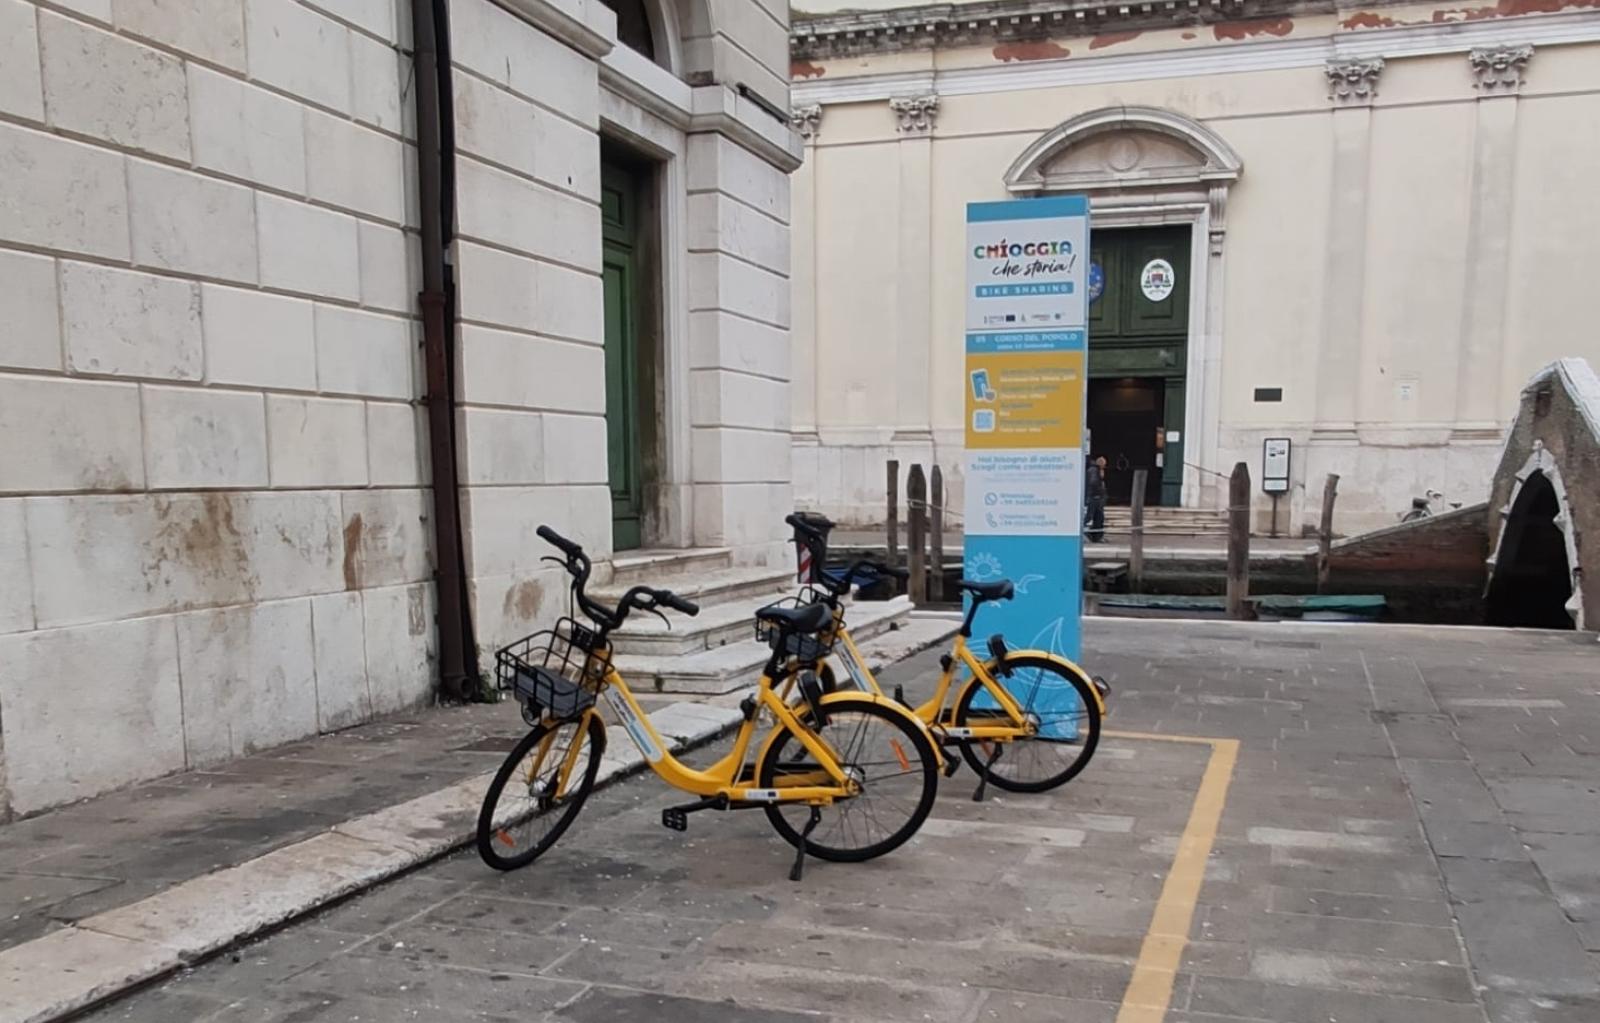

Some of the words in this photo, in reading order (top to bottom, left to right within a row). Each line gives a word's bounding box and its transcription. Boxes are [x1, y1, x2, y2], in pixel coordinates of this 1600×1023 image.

[992, 259, 1022, 277] che
[1023, 254, 1077, 277] storia!
[981, 286, 1008, 296] BIKE
[1014, 284, 1069, 294] SHARING
